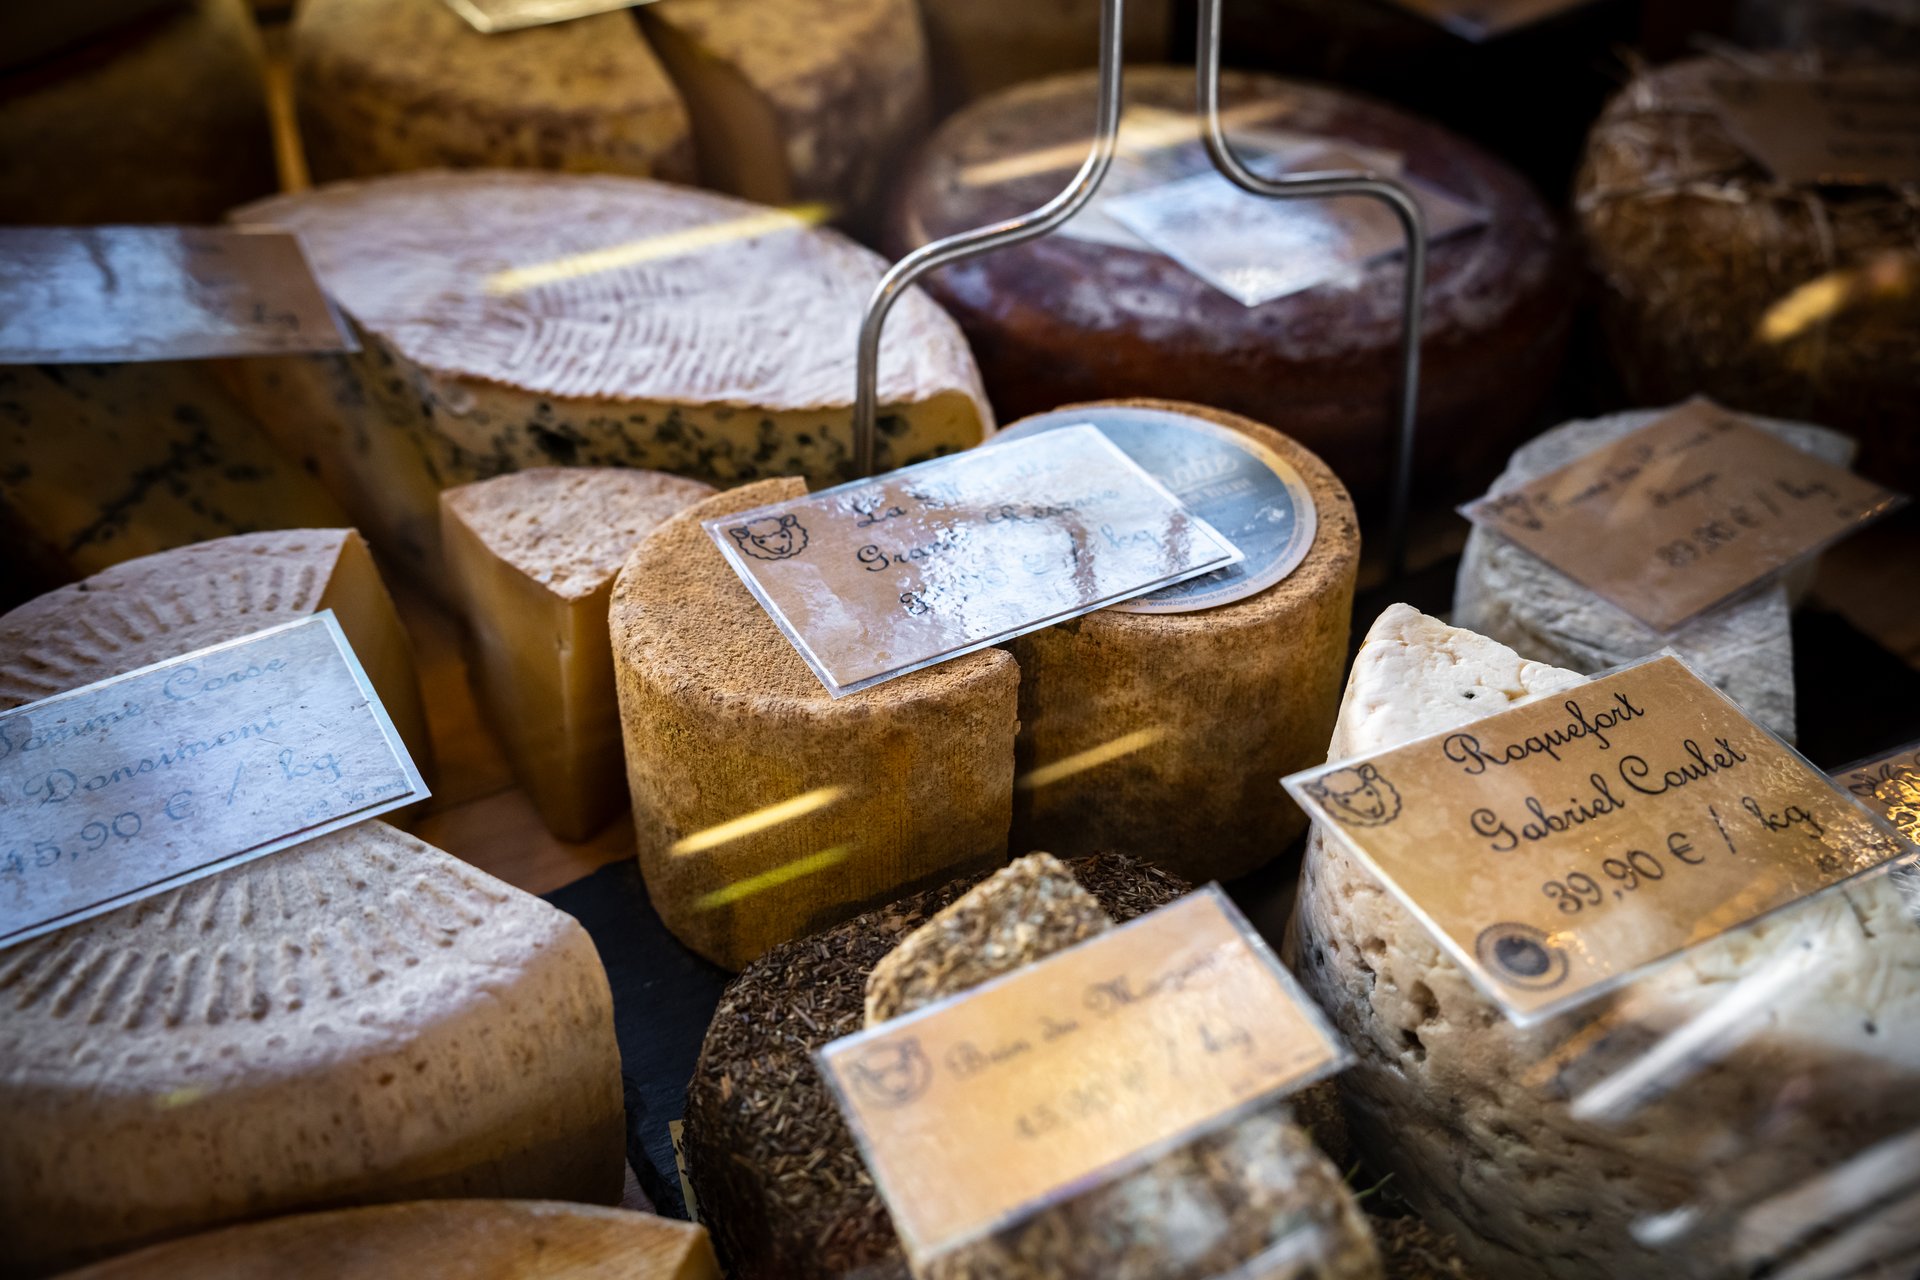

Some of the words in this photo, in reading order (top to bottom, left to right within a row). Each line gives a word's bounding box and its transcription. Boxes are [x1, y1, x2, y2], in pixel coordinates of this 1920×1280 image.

[163, 657, 288, 701] Corse
[23, 709, 285, 808] Donsimoni
[1443, 691, 1645, 776] Roquefort
[0, 811, 142, 875] 45,90
[163, 789, 197, 821] €
[226, 760, 244, 806] /
[277, 748, 342, 784] kg
[1470, 773, 1625, 853] Gabriel
[1618, 736, 1748, 796] Coulet
[1542, 849, 1665, 915] 39,90
[1667, 832, 1707, 866] €
[1709, 806, 1738, 855] /
[1742, 796, 1825, 838] kg
